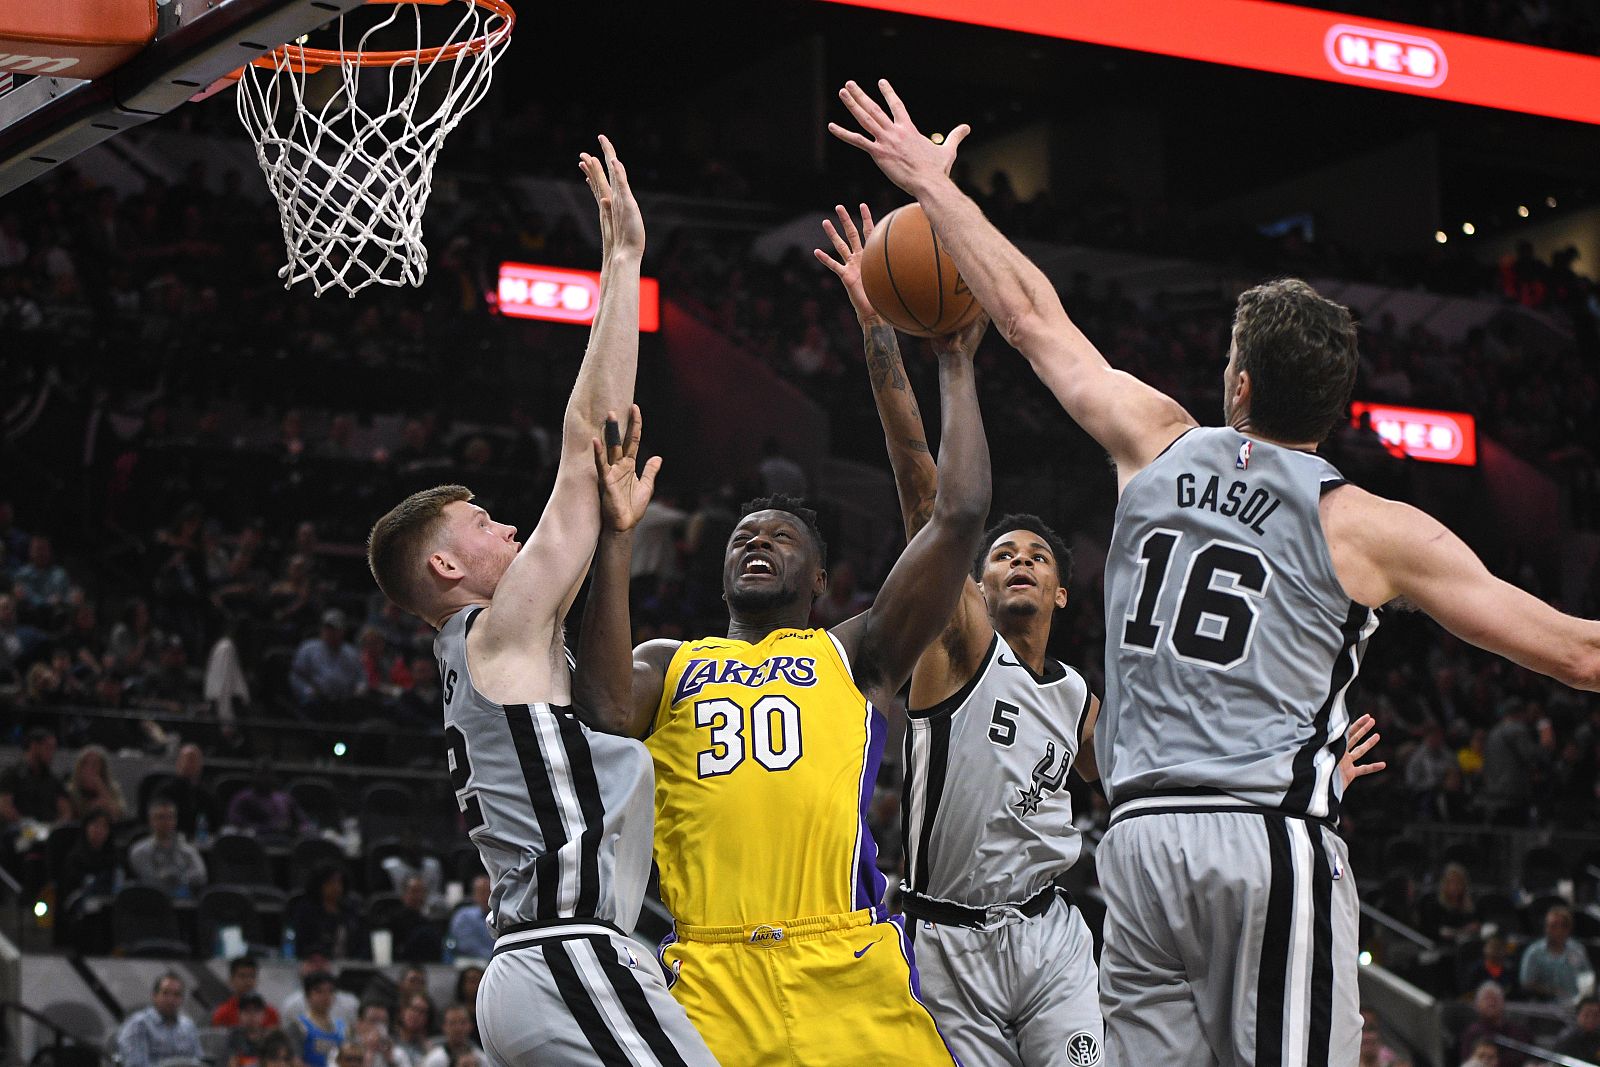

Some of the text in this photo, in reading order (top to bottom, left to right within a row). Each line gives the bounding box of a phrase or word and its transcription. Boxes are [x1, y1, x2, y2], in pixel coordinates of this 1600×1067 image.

[1177, 473, 1282, 536] GASOL
[1119, 527, 1274, 672] 16
[671, 655, 818, 709] LAKERS
[694, 694, 803, 780] 30
[986, 697, 1020, 748] 5
